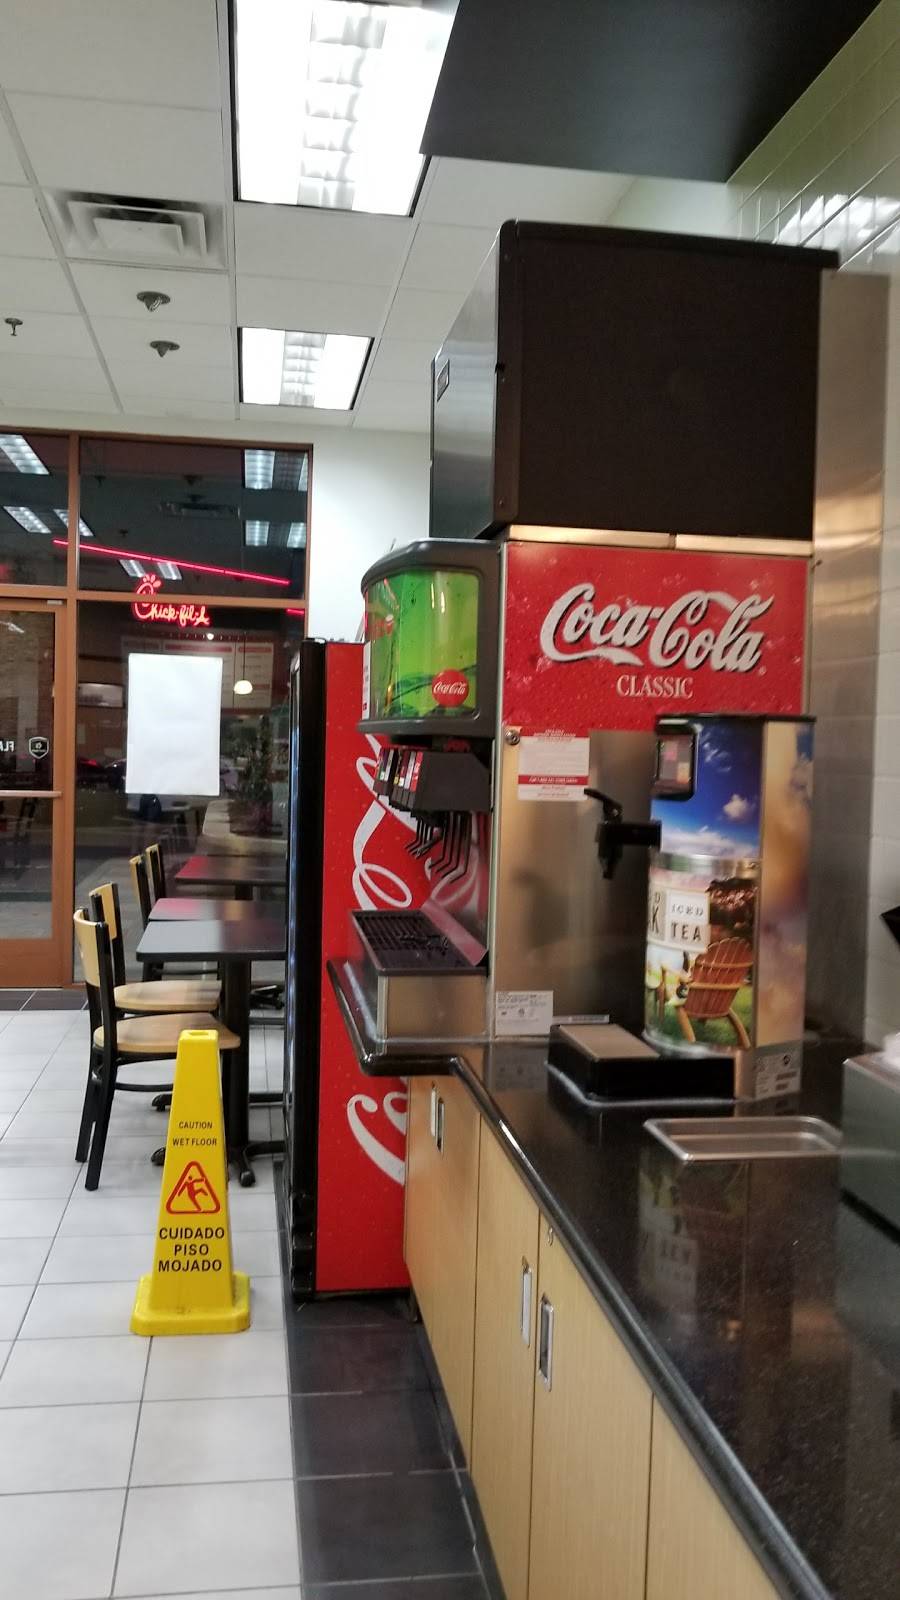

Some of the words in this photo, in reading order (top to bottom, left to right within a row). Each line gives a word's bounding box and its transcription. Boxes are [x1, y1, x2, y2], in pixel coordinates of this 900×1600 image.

[540, 583, 774, 672] Coca-Cola
[616, 674, 693, 699] CLASSIC
[671, 921, 702, 941] TEA
[178, 1121, 213, 1129] CAUTION
[172, 1137, 190, 1146] WET
[191, 1138, 217, 1146] FLOOR
[159, 1227, 225, 1240] CUIDADO
[174, 1243, 209, 1256] PISO
[158, 1259, 223, 1273] MOJADO
